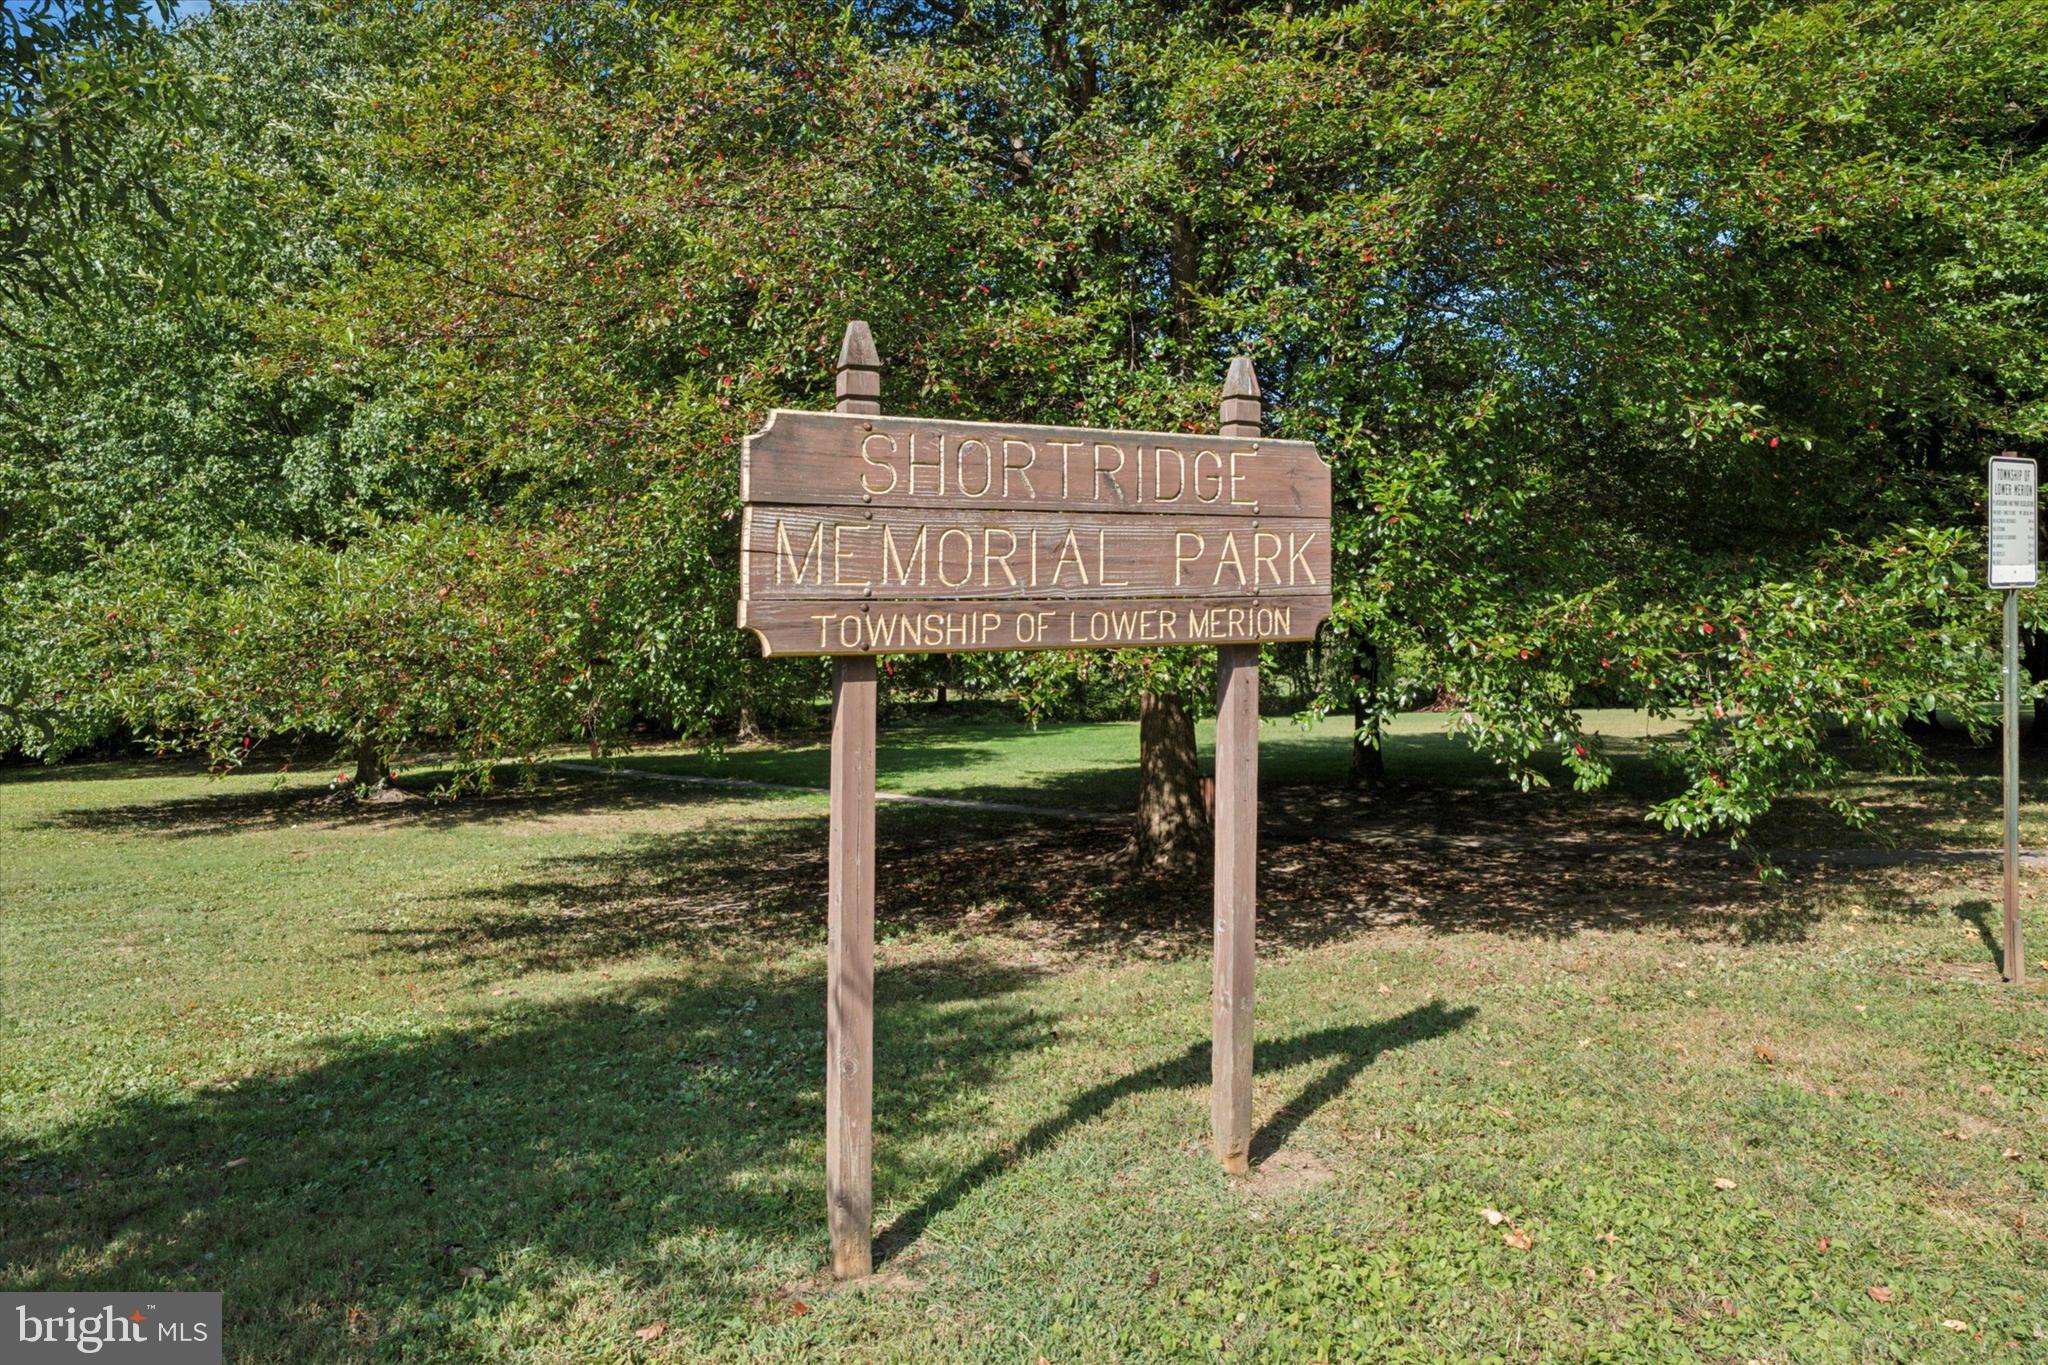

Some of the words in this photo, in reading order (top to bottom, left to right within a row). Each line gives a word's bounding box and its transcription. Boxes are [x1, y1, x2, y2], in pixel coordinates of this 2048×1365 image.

[860, 432, 1258, 506] SHORTRIDGE
[1994, 483, 2011, 495] LOWER
[2014, 484, 2033, 497] MERION
[1997, 468, 2022, 481] TOWNSHIP
[2024, 469, 2031, 482] OF
[774, 518, 1129, 588] MEMORIAL
[1175, 531, 1317, 587] PARK
[811, 612, 1001, 649] TOWNSHIP
[1015, 610, 1057, 644] OF
[1070, 609, 1177, 642] LOWER
[1188, 606, 1291, 639] MERION
